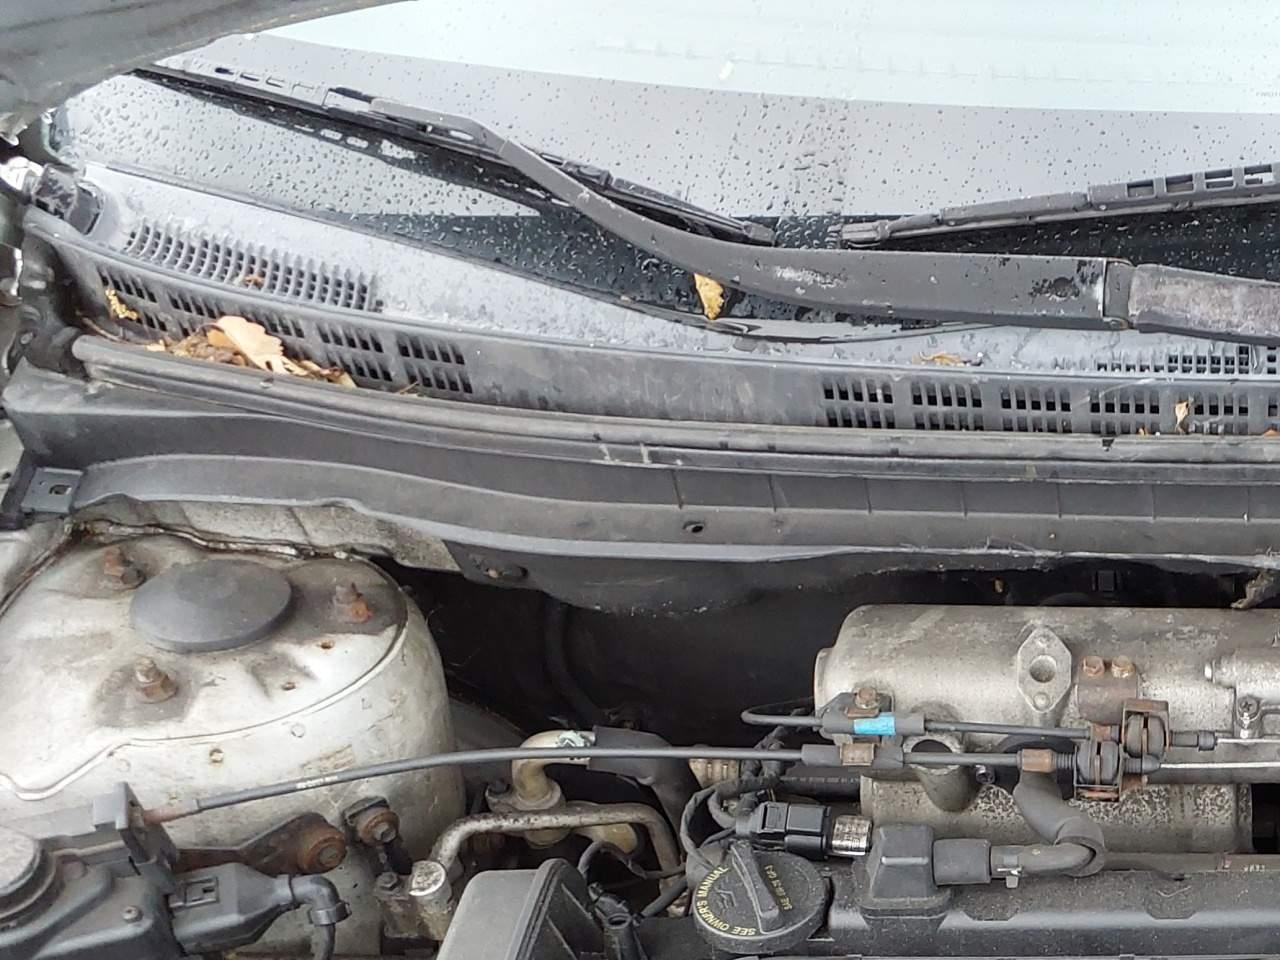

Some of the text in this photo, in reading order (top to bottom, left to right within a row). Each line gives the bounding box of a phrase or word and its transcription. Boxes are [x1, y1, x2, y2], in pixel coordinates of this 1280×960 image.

[696, 865, 757, 936] SEE OWNER'S MANUAL
